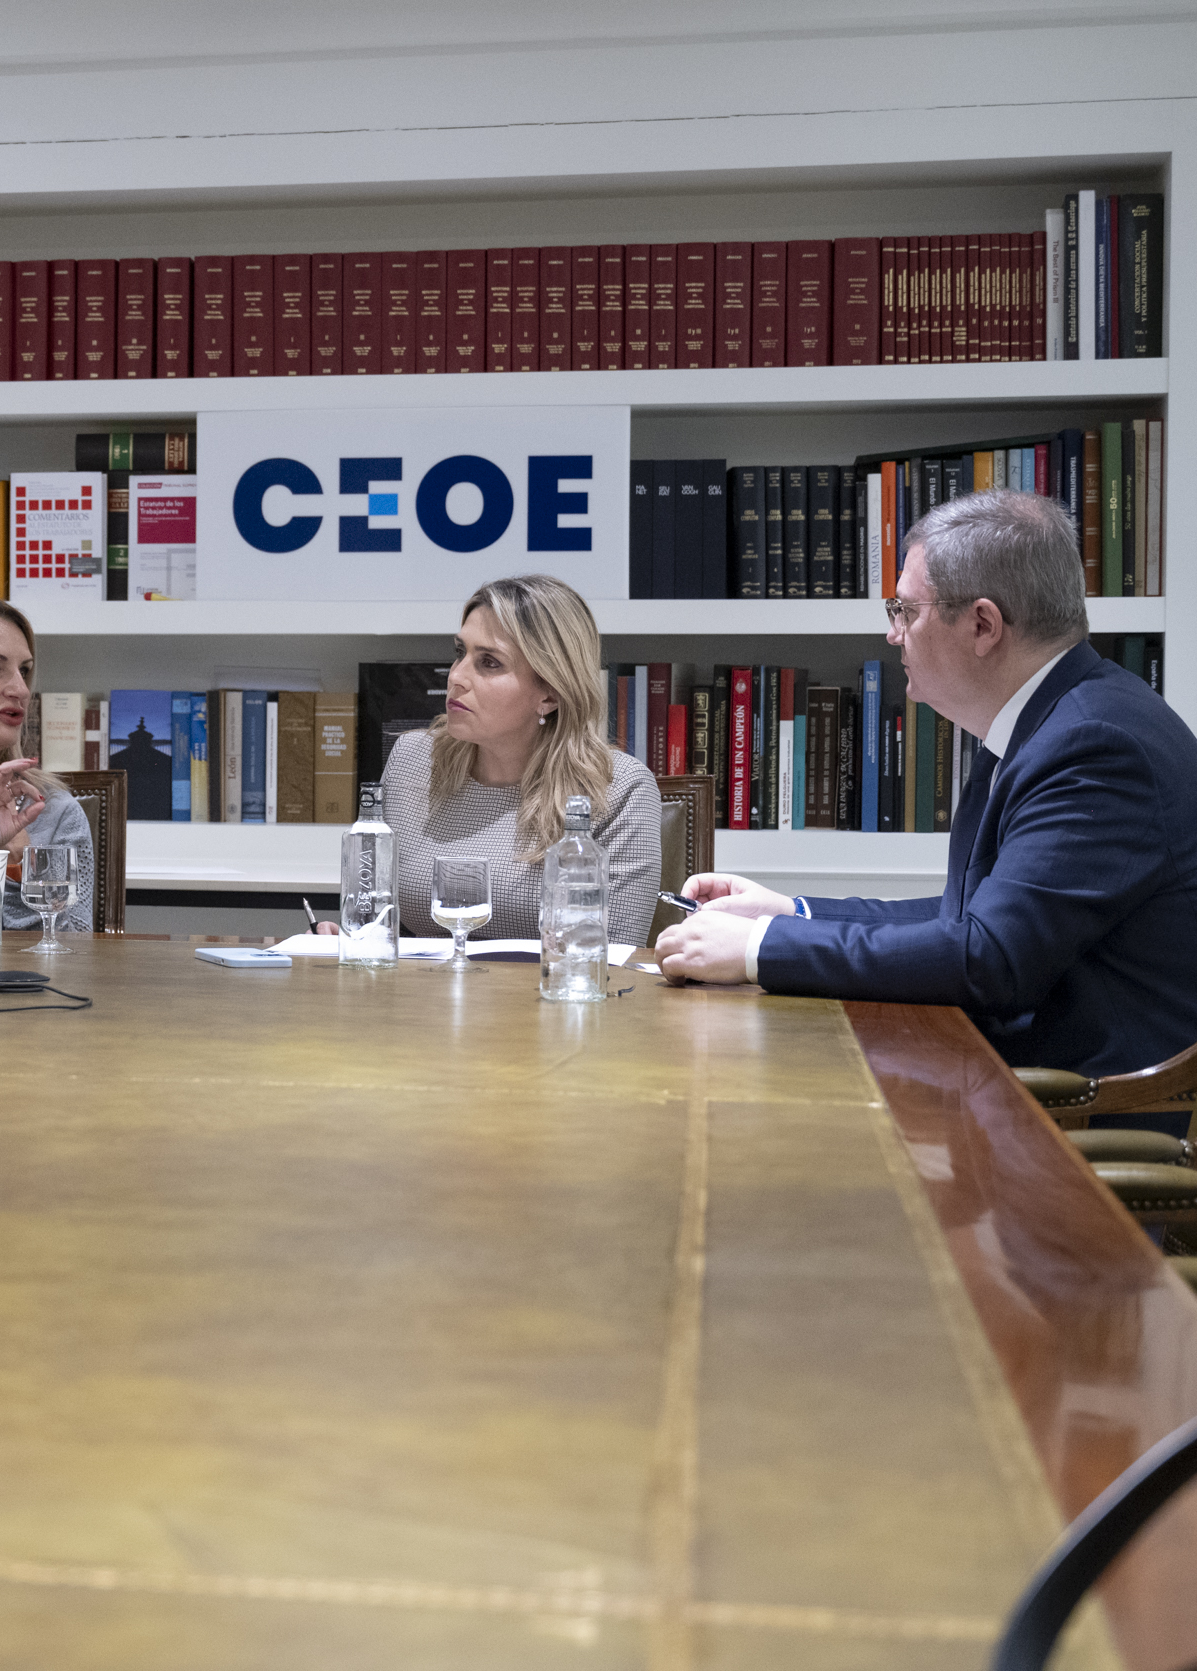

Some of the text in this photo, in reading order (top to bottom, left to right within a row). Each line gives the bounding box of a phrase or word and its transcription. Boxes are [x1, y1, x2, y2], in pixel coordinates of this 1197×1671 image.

[1053, 268, 1059, 276] of
[140, 500, 166, 508] Estatuto
[233, 455, 593, 553] CEOE
[1110, 497, 1117, 509] 50
[28, 513, 89, 521] COMENTARIOS
[140, 508, 178, 516] Trabajadores
[871, 535, 880, 584] ROMANIA
[1151, 681, 1157, 689] de
[228, 757, 236, 780] León
[734, 705, 744, 821] HISTORIA DE UN CAMPEÓN
[768, 784, 777, 824] Enciclopedia
[354, 849, 373, 914] BEZOYA
